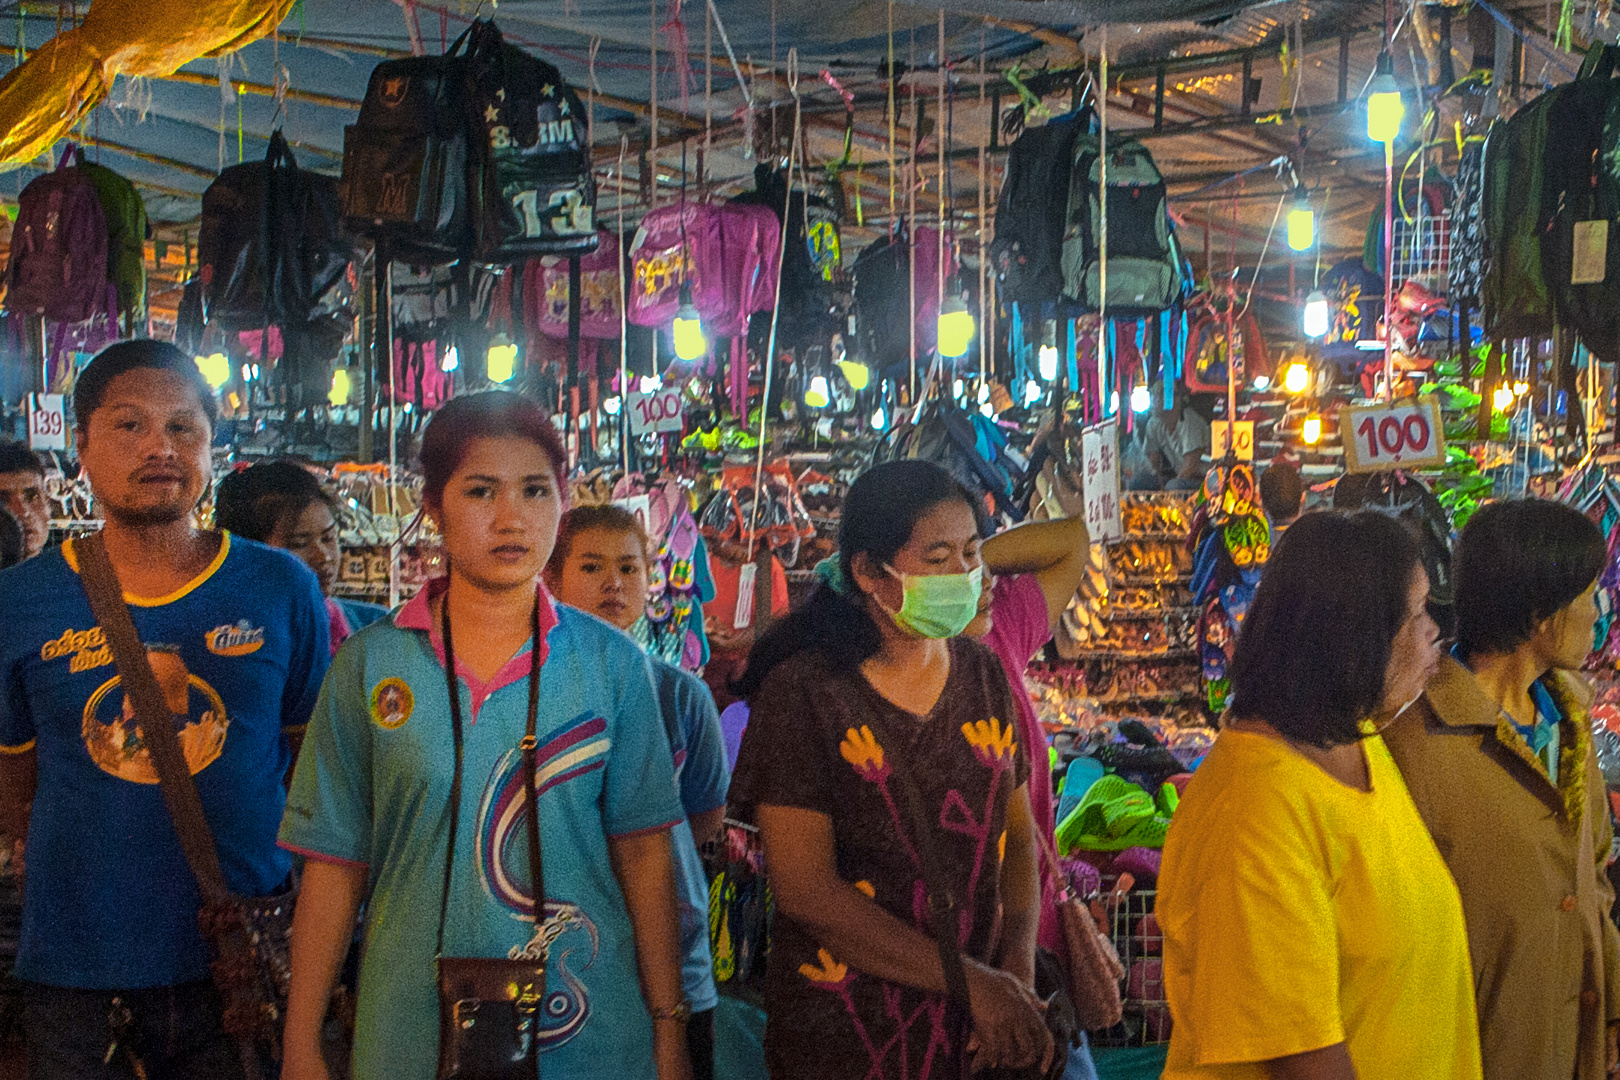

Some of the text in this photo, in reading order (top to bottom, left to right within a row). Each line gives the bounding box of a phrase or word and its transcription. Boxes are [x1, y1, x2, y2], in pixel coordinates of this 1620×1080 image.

[33, 410, 62, 436] 139
[635, 393, 680, 427] 100
[1357, 413, 1430, 458] 100
